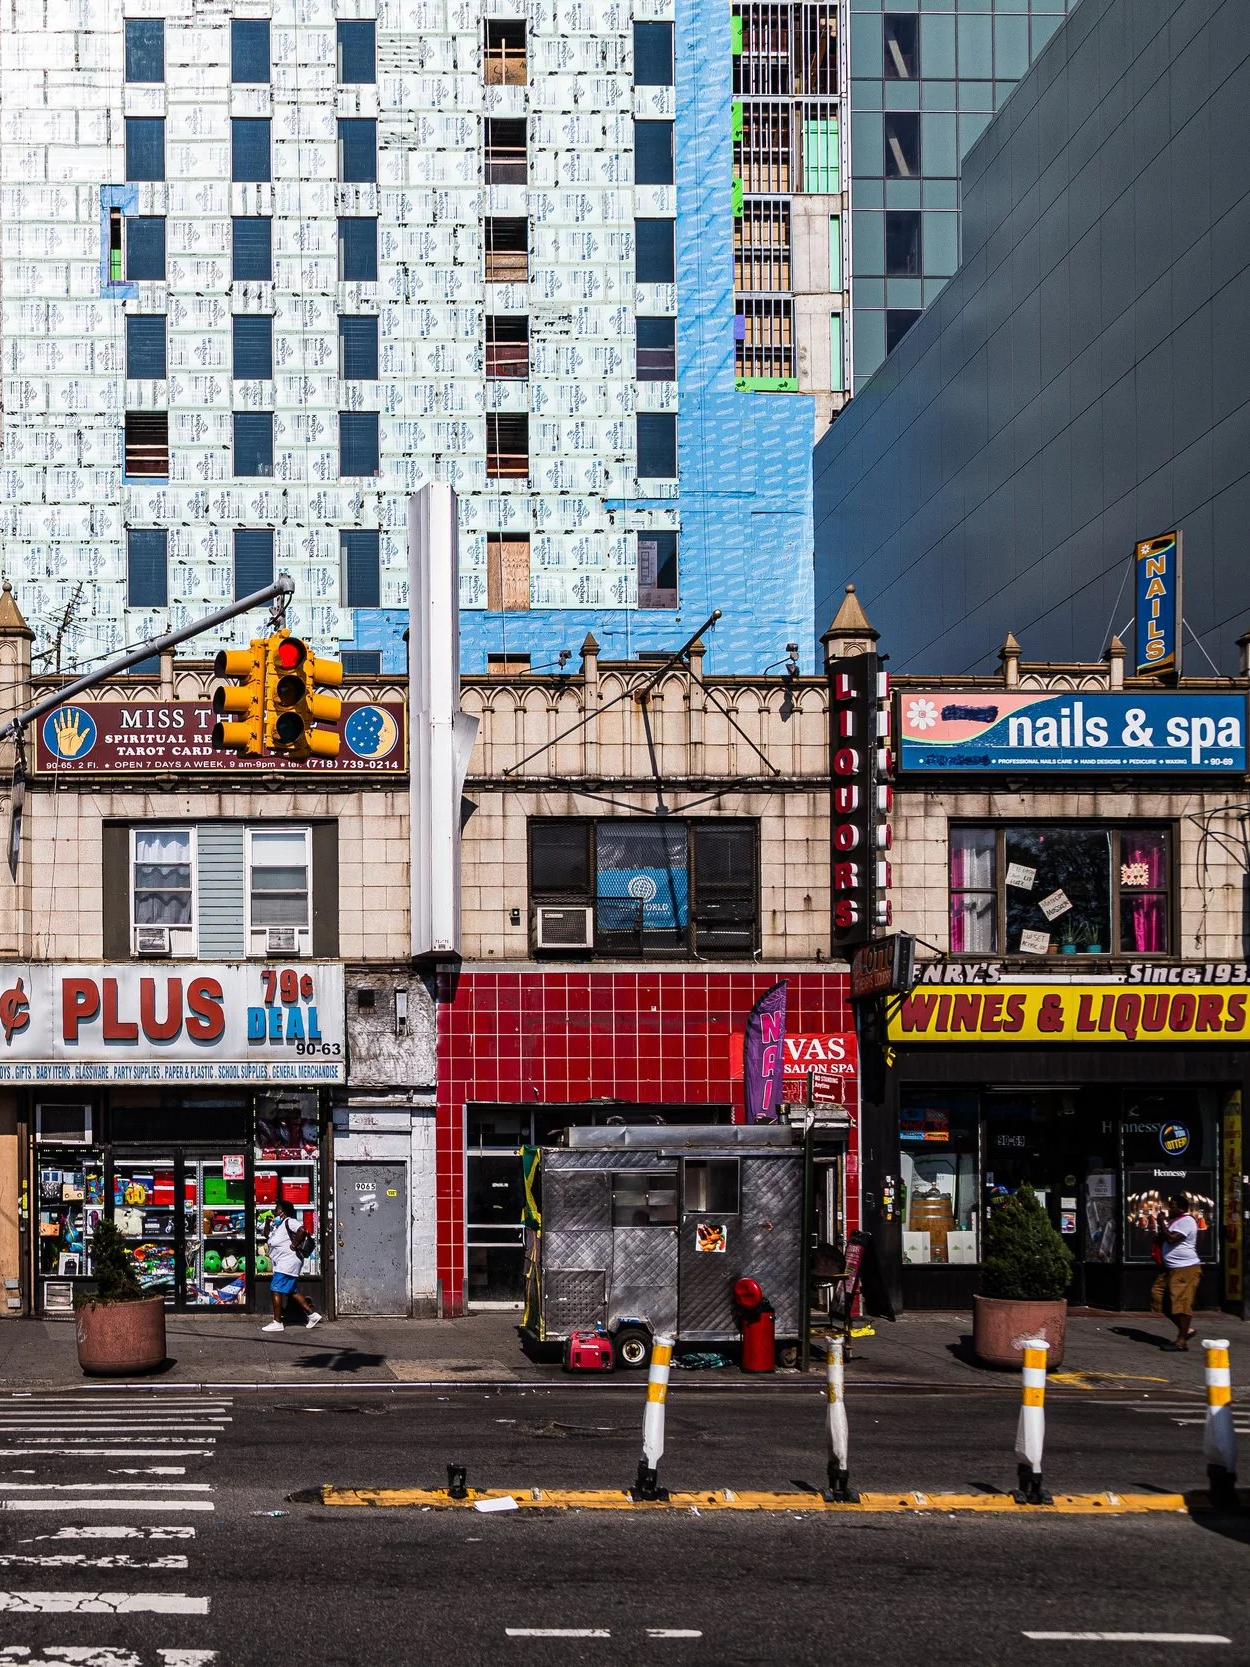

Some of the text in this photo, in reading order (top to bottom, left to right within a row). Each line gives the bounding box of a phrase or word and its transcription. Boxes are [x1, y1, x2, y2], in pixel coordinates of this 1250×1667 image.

[1145, 554, 1166, 661] NAILS
[120, 709, 185, 729] MISS
[105, 734, 186, 744] SPIRITUAL
[1009, 702, 1241, 765] nails & spa
[116, 747, 212, 756] TAROT CARD
[46, 762, 75, 770] 90-65,
[114, 761, 143, 769] OPEN
[146, 761, 151, 769] 7
[154, 761, 182, 769] DAYS
[184, 761, 191, 769] A
[194, 761, 226, 770] WEEK,
[238, 761, 276, 770] am-9pm
[306, 759, 339, 769] (718)
[342, 760, 399, 769] 739-0214
[834, 673, 859, 927] LIQUORS
[912, 963, 1000, 984] ENRY'S
[1128, 964, 1197, 984] Since
[1204, 964, 1250, 984] 193
[260, 969, 314, 1004] 79¢
[61, 977, 226, 1041] PLUS
[900, 993, 1248, 1041] WINES & LIQUORS
[247, 1006, 322, 1040] DEAL
[296, 1043, 341, 1056] 90-63
[15, 1066, 32, 1080] GIFTS
[37, 1066, 51, 1080] BABY
[52, 1065, 71, 1080] ITEMS
[75, 1065, 109, 1080] GLASSWARE
[114, 1065, 133, 1080] PARTY
[133, 1065, 160, 1080] SUPPLIES
[164, 1065, 184, 1079] PAPER
[184, 1065, 189, 1079] &
[190, 1065, 214, 1079] PLASTIC
[218, 1065, 239, 1079] SCHOOL
[240, 1065, 268, 1079] SUPPLIES
[272, 1065, 297, 1079] GENERAL
[299, 1065, 338, 1079] MERCHANDISE
[783, 1063, 855, 1074] SALON SPA
[820, 1075, 839, 1084] STANDING
[1153, 1169, 1188, 1179] Hennessy
